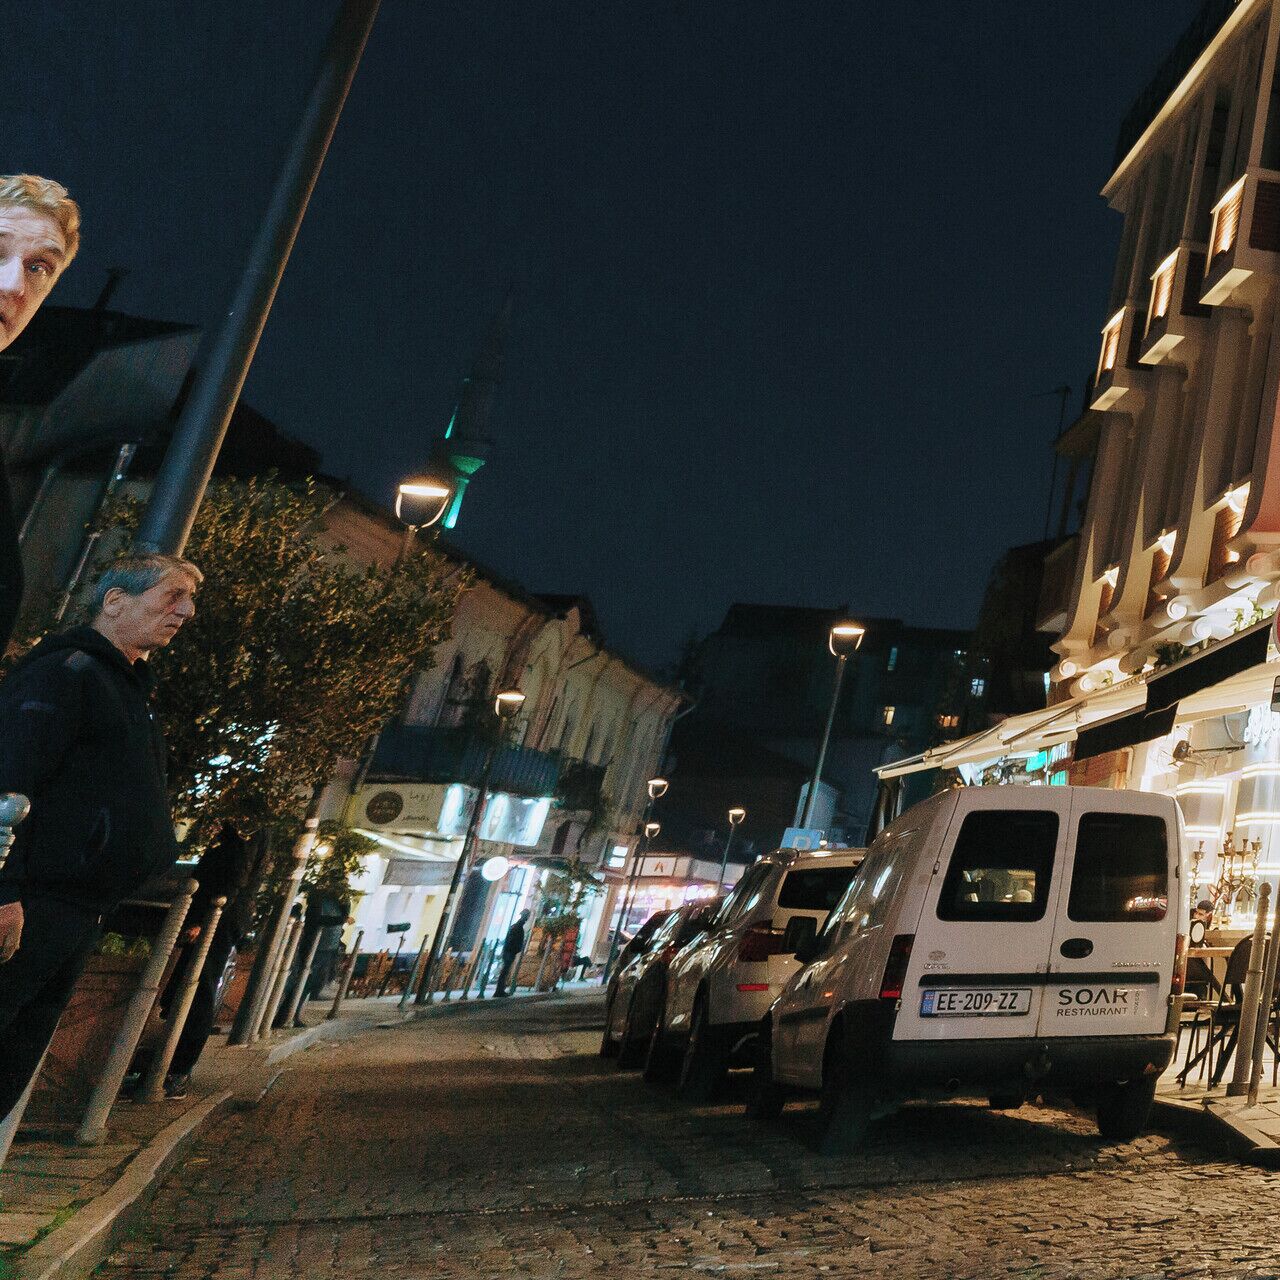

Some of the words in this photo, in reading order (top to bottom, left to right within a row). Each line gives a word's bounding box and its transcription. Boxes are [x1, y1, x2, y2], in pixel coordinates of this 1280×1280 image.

[936, 992, 1019, 1011] EE-209-ZZ
[1058, 988, 1129, 1006] SOAR
[1056, 1007, 1128, 1017] RESTAURANT
